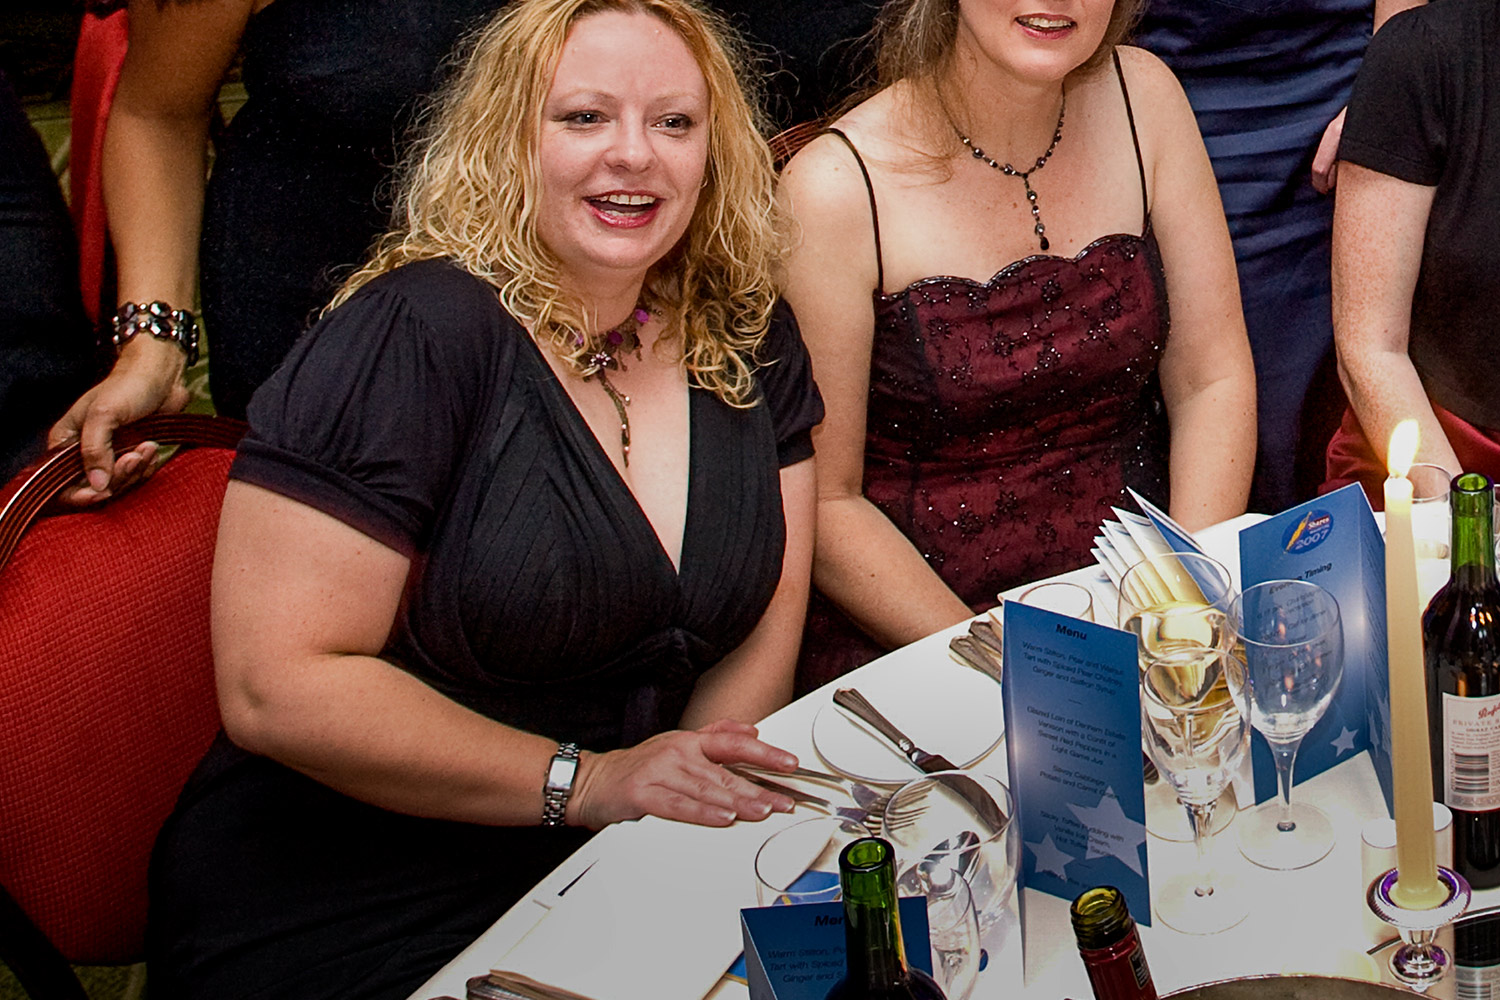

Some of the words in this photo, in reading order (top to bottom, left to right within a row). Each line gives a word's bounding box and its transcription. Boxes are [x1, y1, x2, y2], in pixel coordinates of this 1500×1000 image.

[1295, 528, 1329, 550] 2007
[1305, 563, 1332, 579] Timing
[1055, 624, 1087, 640] Menu
